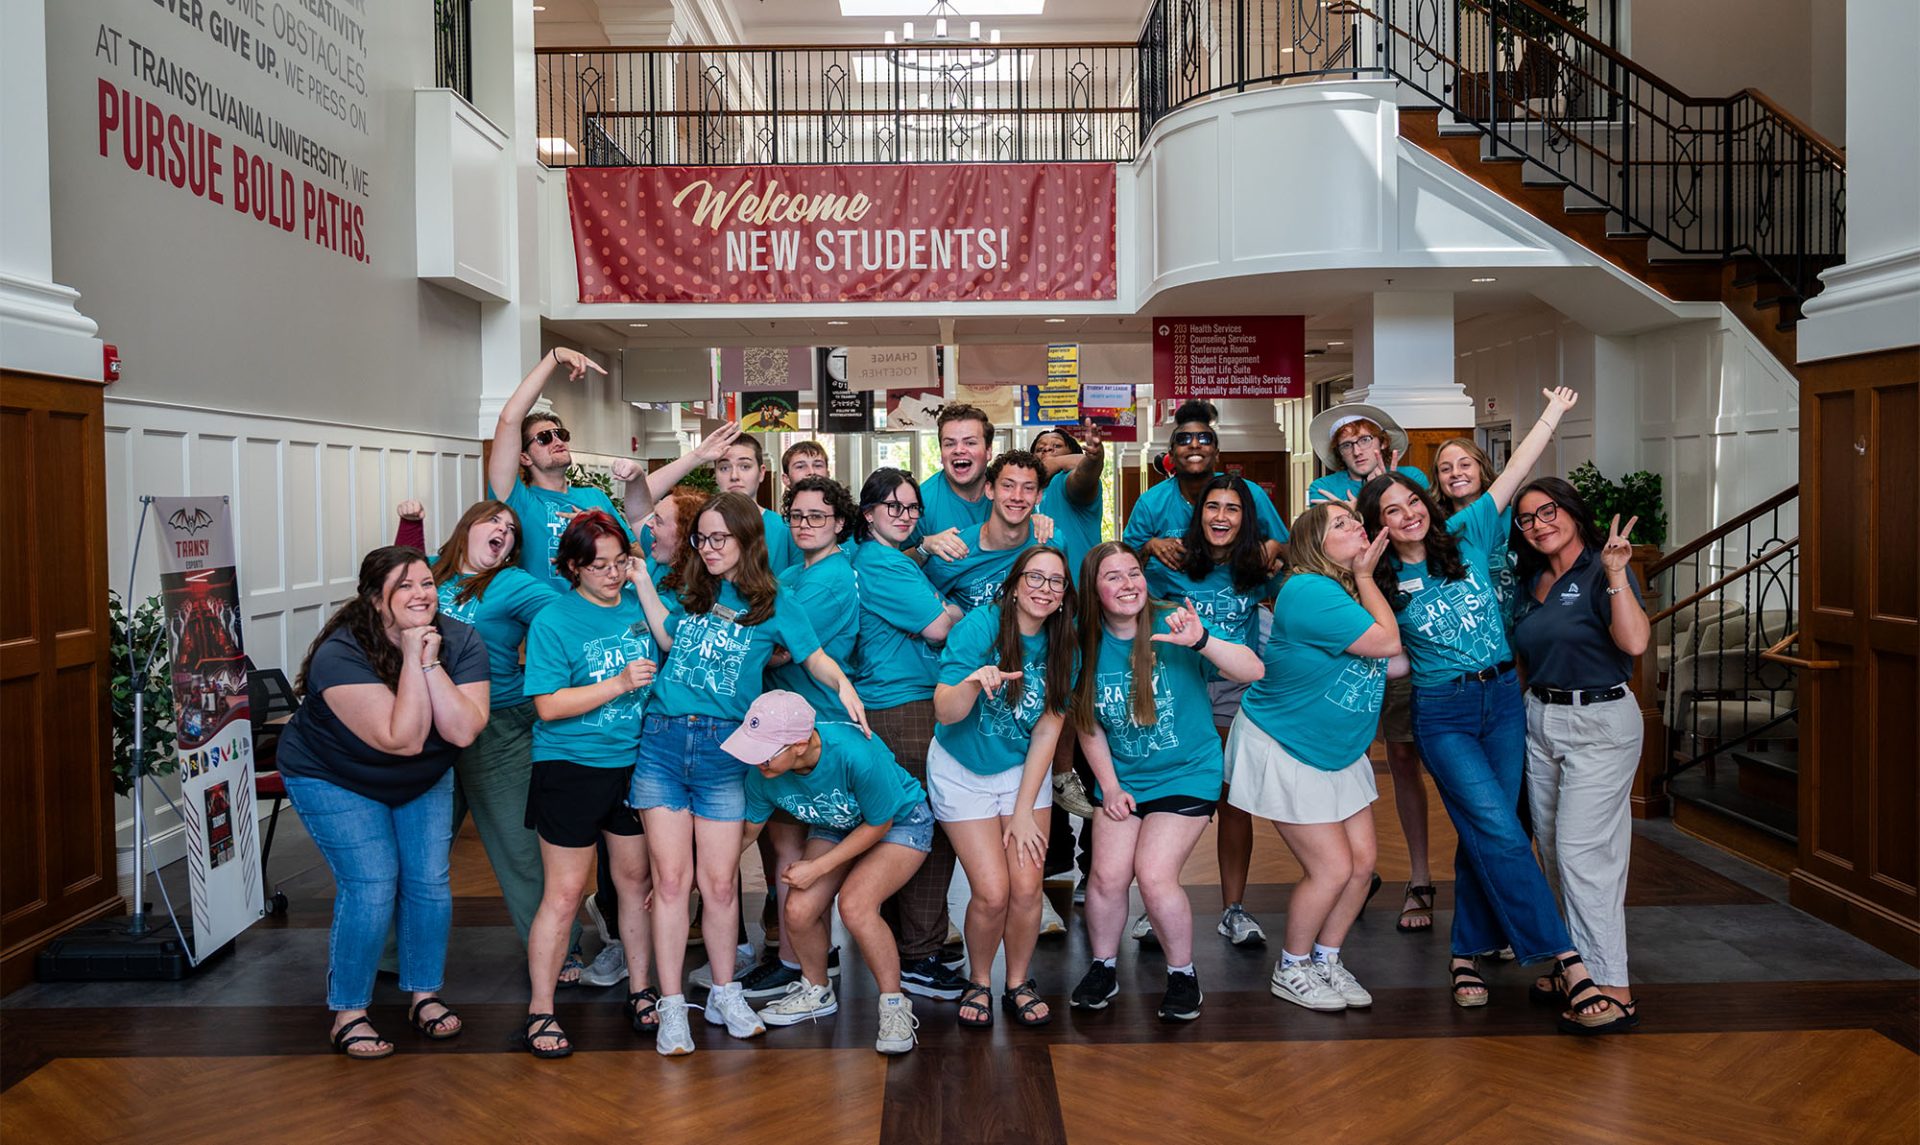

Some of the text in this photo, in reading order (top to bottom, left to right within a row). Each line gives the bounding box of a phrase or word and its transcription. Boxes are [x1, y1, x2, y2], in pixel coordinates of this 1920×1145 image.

[273, 3, 368, 97] OBSTACLES.
[210, 10, 250, 61] GIVE
[256, 39, 279, 79] UP.
[284, 57, 304, 95] WE
[309, 74, 346, 121] PRESS
[350, 103, 369, 136] ON.
[96, 24, 369, 198] AT TRANSYLVANIA UNIVERSITY, WE
[98, 77, 370, 264] PURSUE BOLD PATHS.
[672, 180, 872, 231] Welcome
[726, 228, 1008, 272] NEW STUDENTS!
[1190, 324, 1212, 333] Health
[1213, 324, 1242, 333] Services
[1174, 334, 1256, 345] 212 Counseling Services
[1190, 344, 1229, 353] Conference
[1230, 344, 1249, 353] Room
[1190, 355, 1217, 364] Student
[1219, 354, 1260, 366] Engagement
[1174, 365, 1251, 374] 231 Student Life Suite
[1191, 375, 1206, 384] Title
[1208, 375, 1215, 384] IX
[1216, 375, 1229, 384] and
[1231, 374, 1261, 386] Disability
[1263, 374, 1291, 384] Services
[1174, 385, 1287, 397] 244 Spirituality and Religious Life
[175, 540, 209, 558] TRANSY
